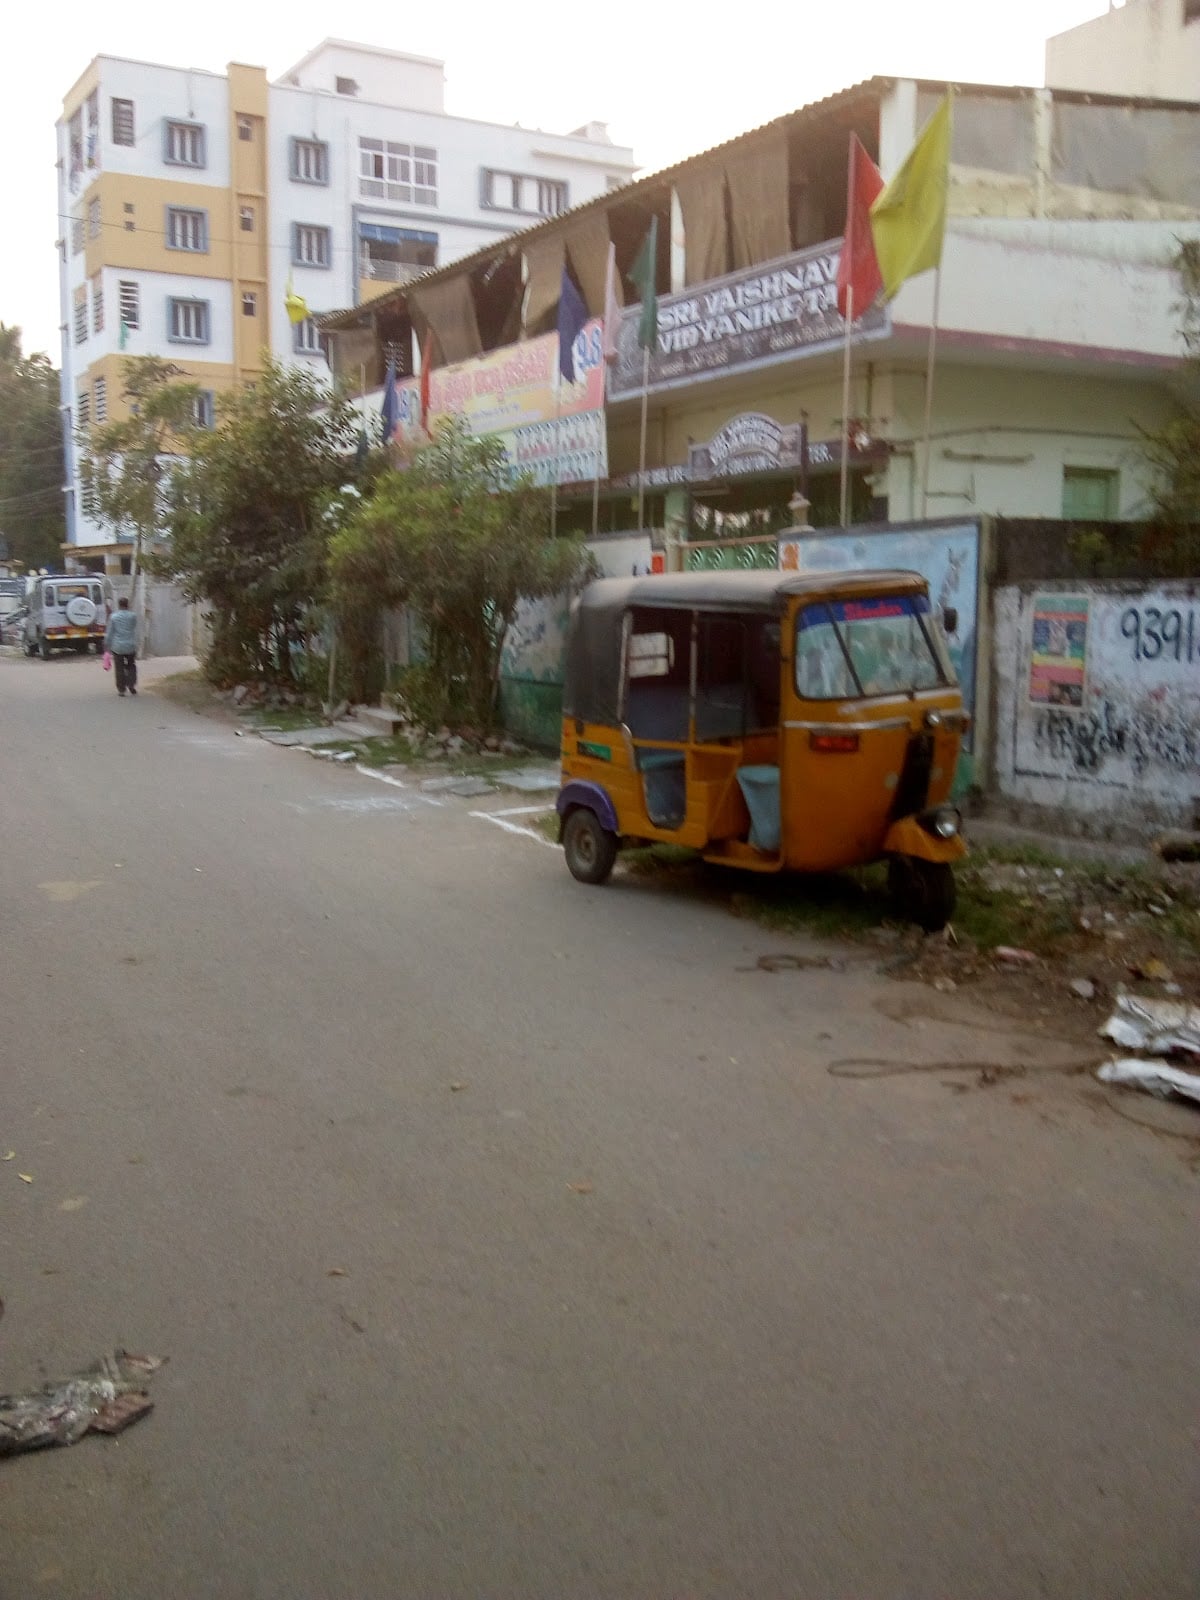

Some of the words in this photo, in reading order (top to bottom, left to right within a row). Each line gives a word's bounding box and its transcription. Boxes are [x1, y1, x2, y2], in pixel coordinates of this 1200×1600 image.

[656, 301, 700, 332] SRI
[704, 253, 841, 316] VAISHNAV
[1120, 607, 1200, 664] 9391
